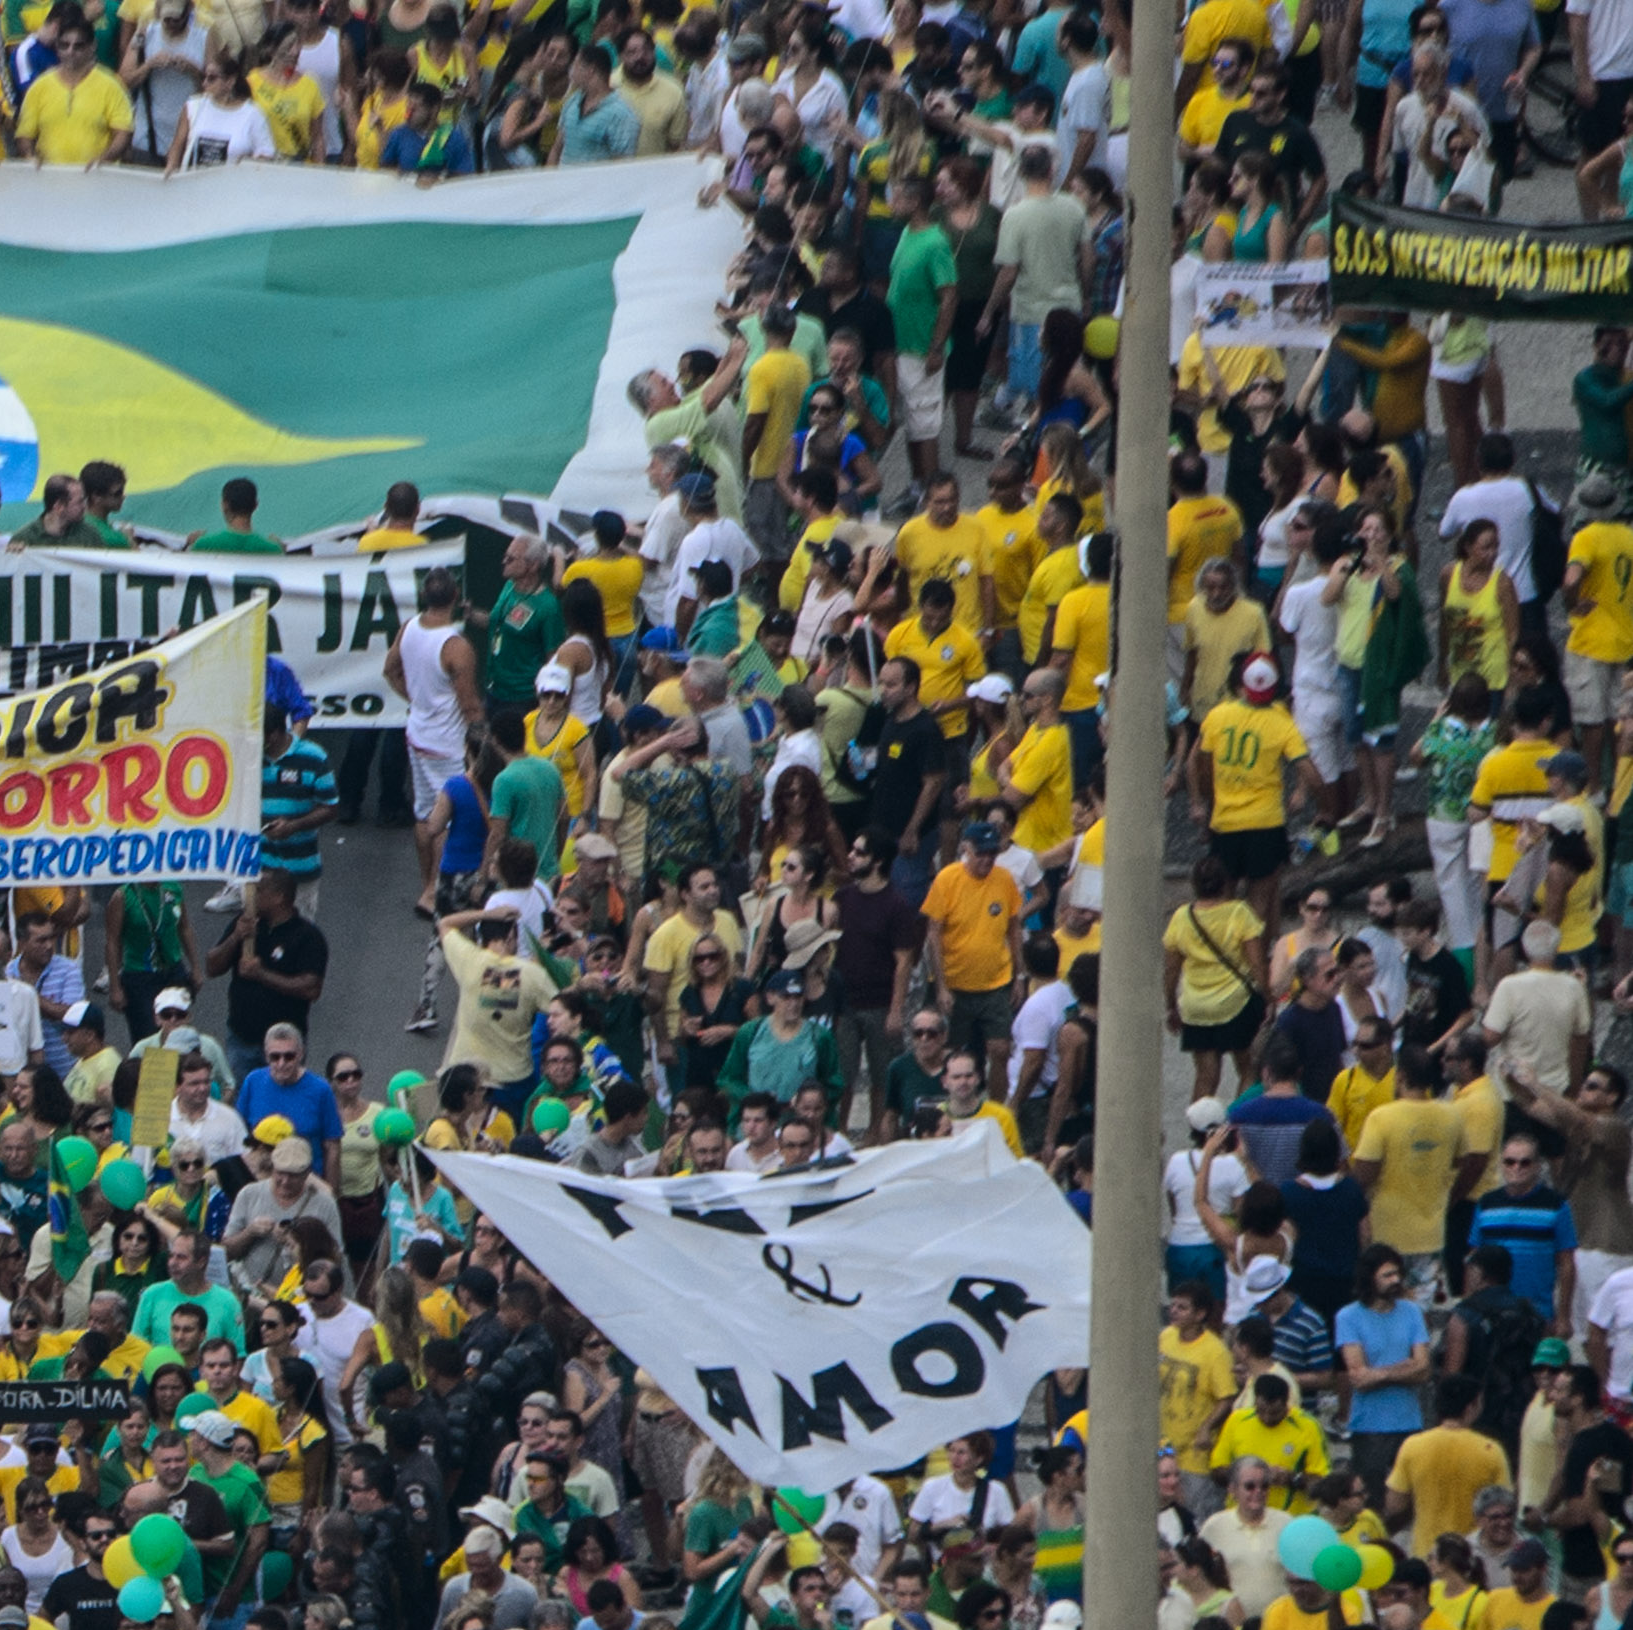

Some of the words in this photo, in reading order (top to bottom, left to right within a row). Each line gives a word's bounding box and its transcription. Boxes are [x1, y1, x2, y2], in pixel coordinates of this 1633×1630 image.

[1333, 225, 1388, 277] S.O.S
[1391, 228, 1544, 300] INTERVENÇÃO
[1544, 241, 1632, 295] MILITAR
[1218, 725, 1259, 769] 10
[694, 1275, 1051, 1451] AMOR
